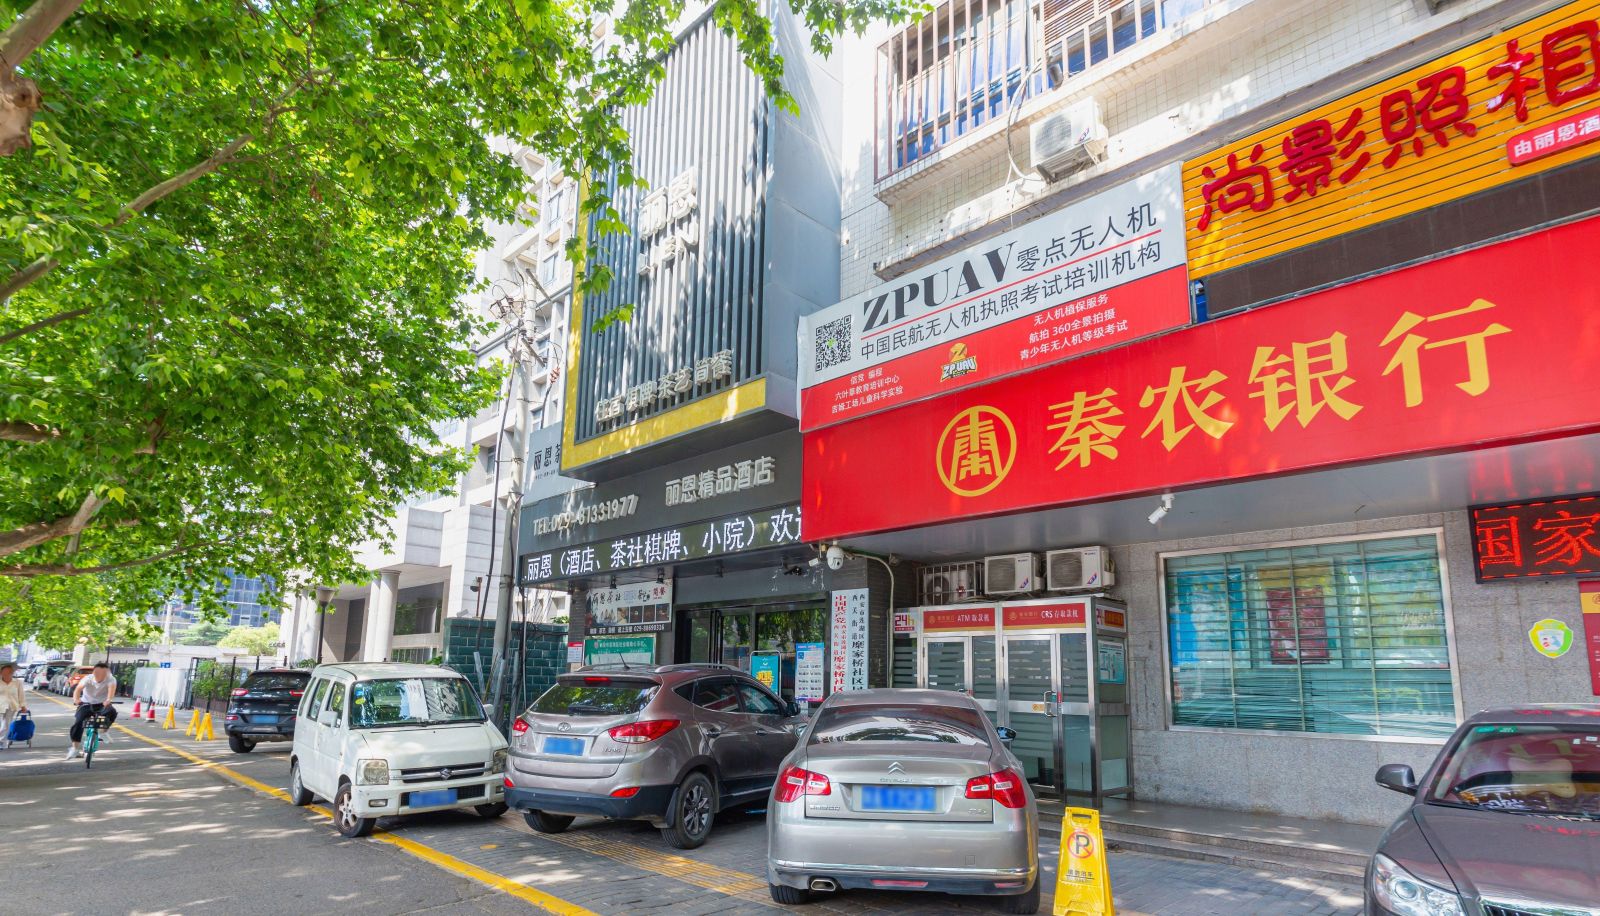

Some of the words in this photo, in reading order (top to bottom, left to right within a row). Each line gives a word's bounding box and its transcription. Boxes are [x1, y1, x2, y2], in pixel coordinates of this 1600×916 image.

[1197, 19, 1600, 231] 尚影照相
[860, 240, 1163, 361] 中国民航无人机执照考试培训机构
[862, 240, 1019, 333] ZPUAV
[1016, 202, 1158, 273] 零点无人机
[1033, 293, 1110, 327] 无人机植保服务
[1019, 319, 1129, 361] 青少年无人机等级考试
[1046, 297, 1512, 472] 秦农银行
[665, 455, 776, 507] 丽恩精品酒店
[1477, 509, 1600, 568] 国家
